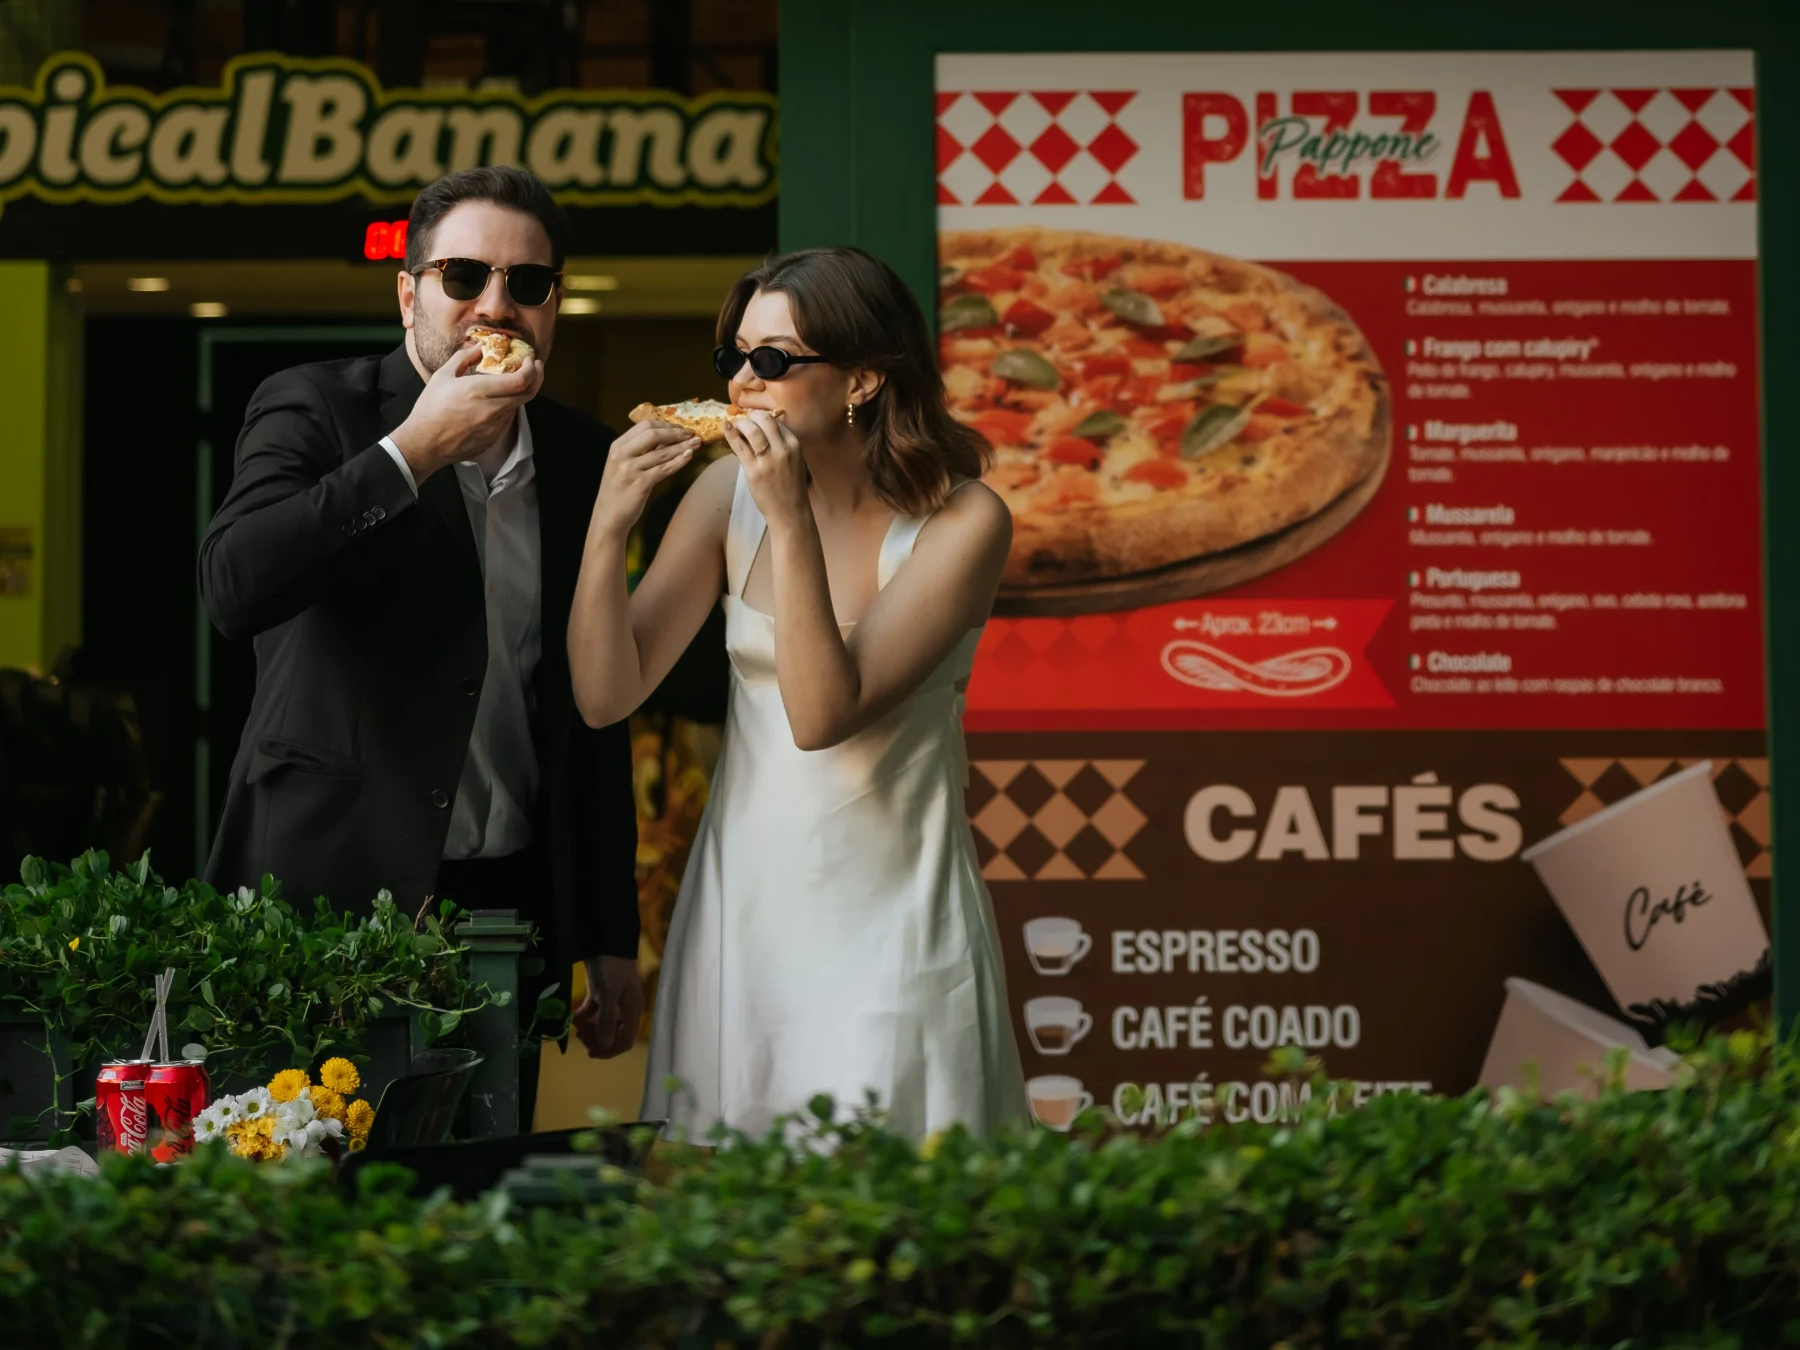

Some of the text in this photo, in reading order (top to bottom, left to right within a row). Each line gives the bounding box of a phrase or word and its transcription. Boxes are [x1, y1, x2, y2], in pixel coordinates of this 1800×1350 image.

[1181, 90, 1522, 201] PIZZA
[1259, 115, 1441, 176] Pappone
[1422, 274, 1508, 295] Calabresa
[1423, 337, 1481, 361] Frango
[1484, 339, 1521, 357] com
[1425, 504, 1515, 525] Mussarela
[1426, 567, 1521, 592] Portuguesa
[1426, 651, 1512, 672] Chocolate
[1184, 770, 1523, 862] CAFÉS
[1624, 881, 1713, 951] Café
[1111, 930, 1320, 973] ESPRESSO
[1111, 997, 1361, 1049] CAFÉ COADO
[1111, 1072, 1214, 1125] CAFÉ
[1222, 1081, 1312, 1124] COM
